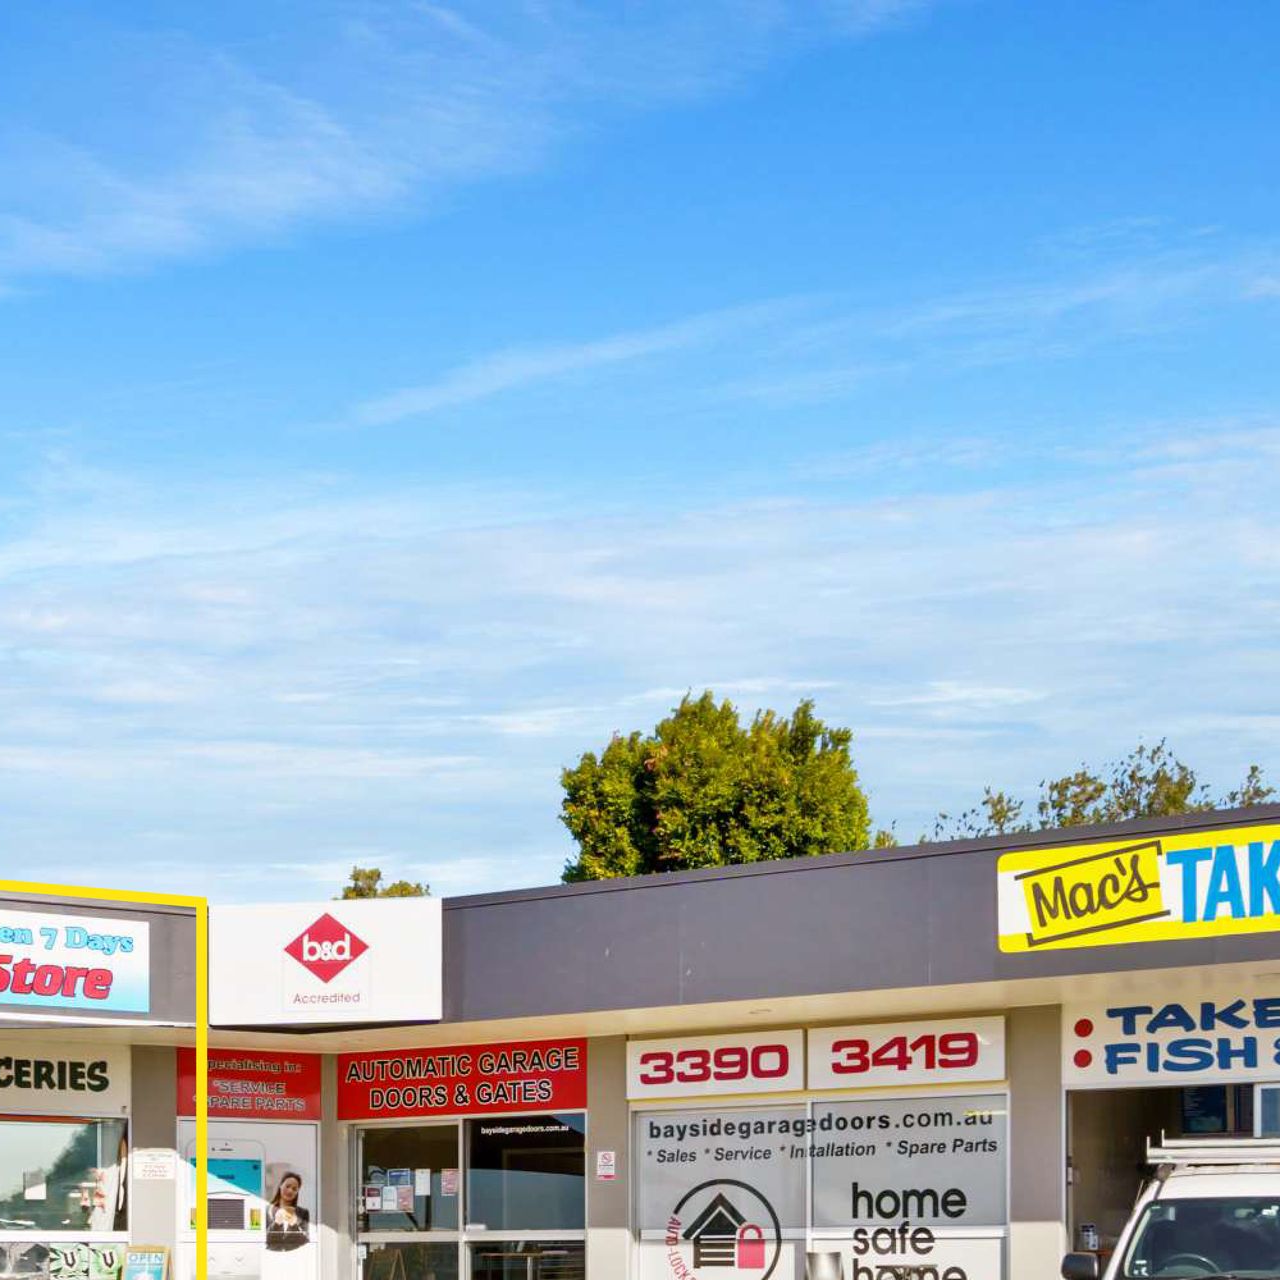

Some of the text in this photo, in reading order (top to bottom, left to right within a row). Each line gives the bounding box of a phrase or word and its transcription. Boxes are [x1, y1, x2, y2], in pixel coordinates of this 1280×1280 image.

[1030, 853, 1160, 928] Mac's
[39, 928, 58, 951] 7
[66, 927, 135, 955] Days
[302, 932, 352, 961] b&d
[293, 993, 361, 1004] Accredited
[206, 1059, 281, 1075] pecialising
[345, 1047, 579, 1083] AUTOMATIC GARAGE
[639, 1032, 979, 1085] 3390 3419
[1104, 1033, 1258, 1075] FISH
[207, 1095, 306, 1112] PARE PARTS
[370, 1079, 553, 1109] DOORS & GATES
[481, 1124, 570, 1136] baysidegaragedoors.com.au
[657, 1137, 998, 1163] Sales Service Intallation Spare Parts
[852, 1181, 967, 1219] home
[853, 1221, 936, 1255] safe
[128, 1253, 164, 1265] OPEN
